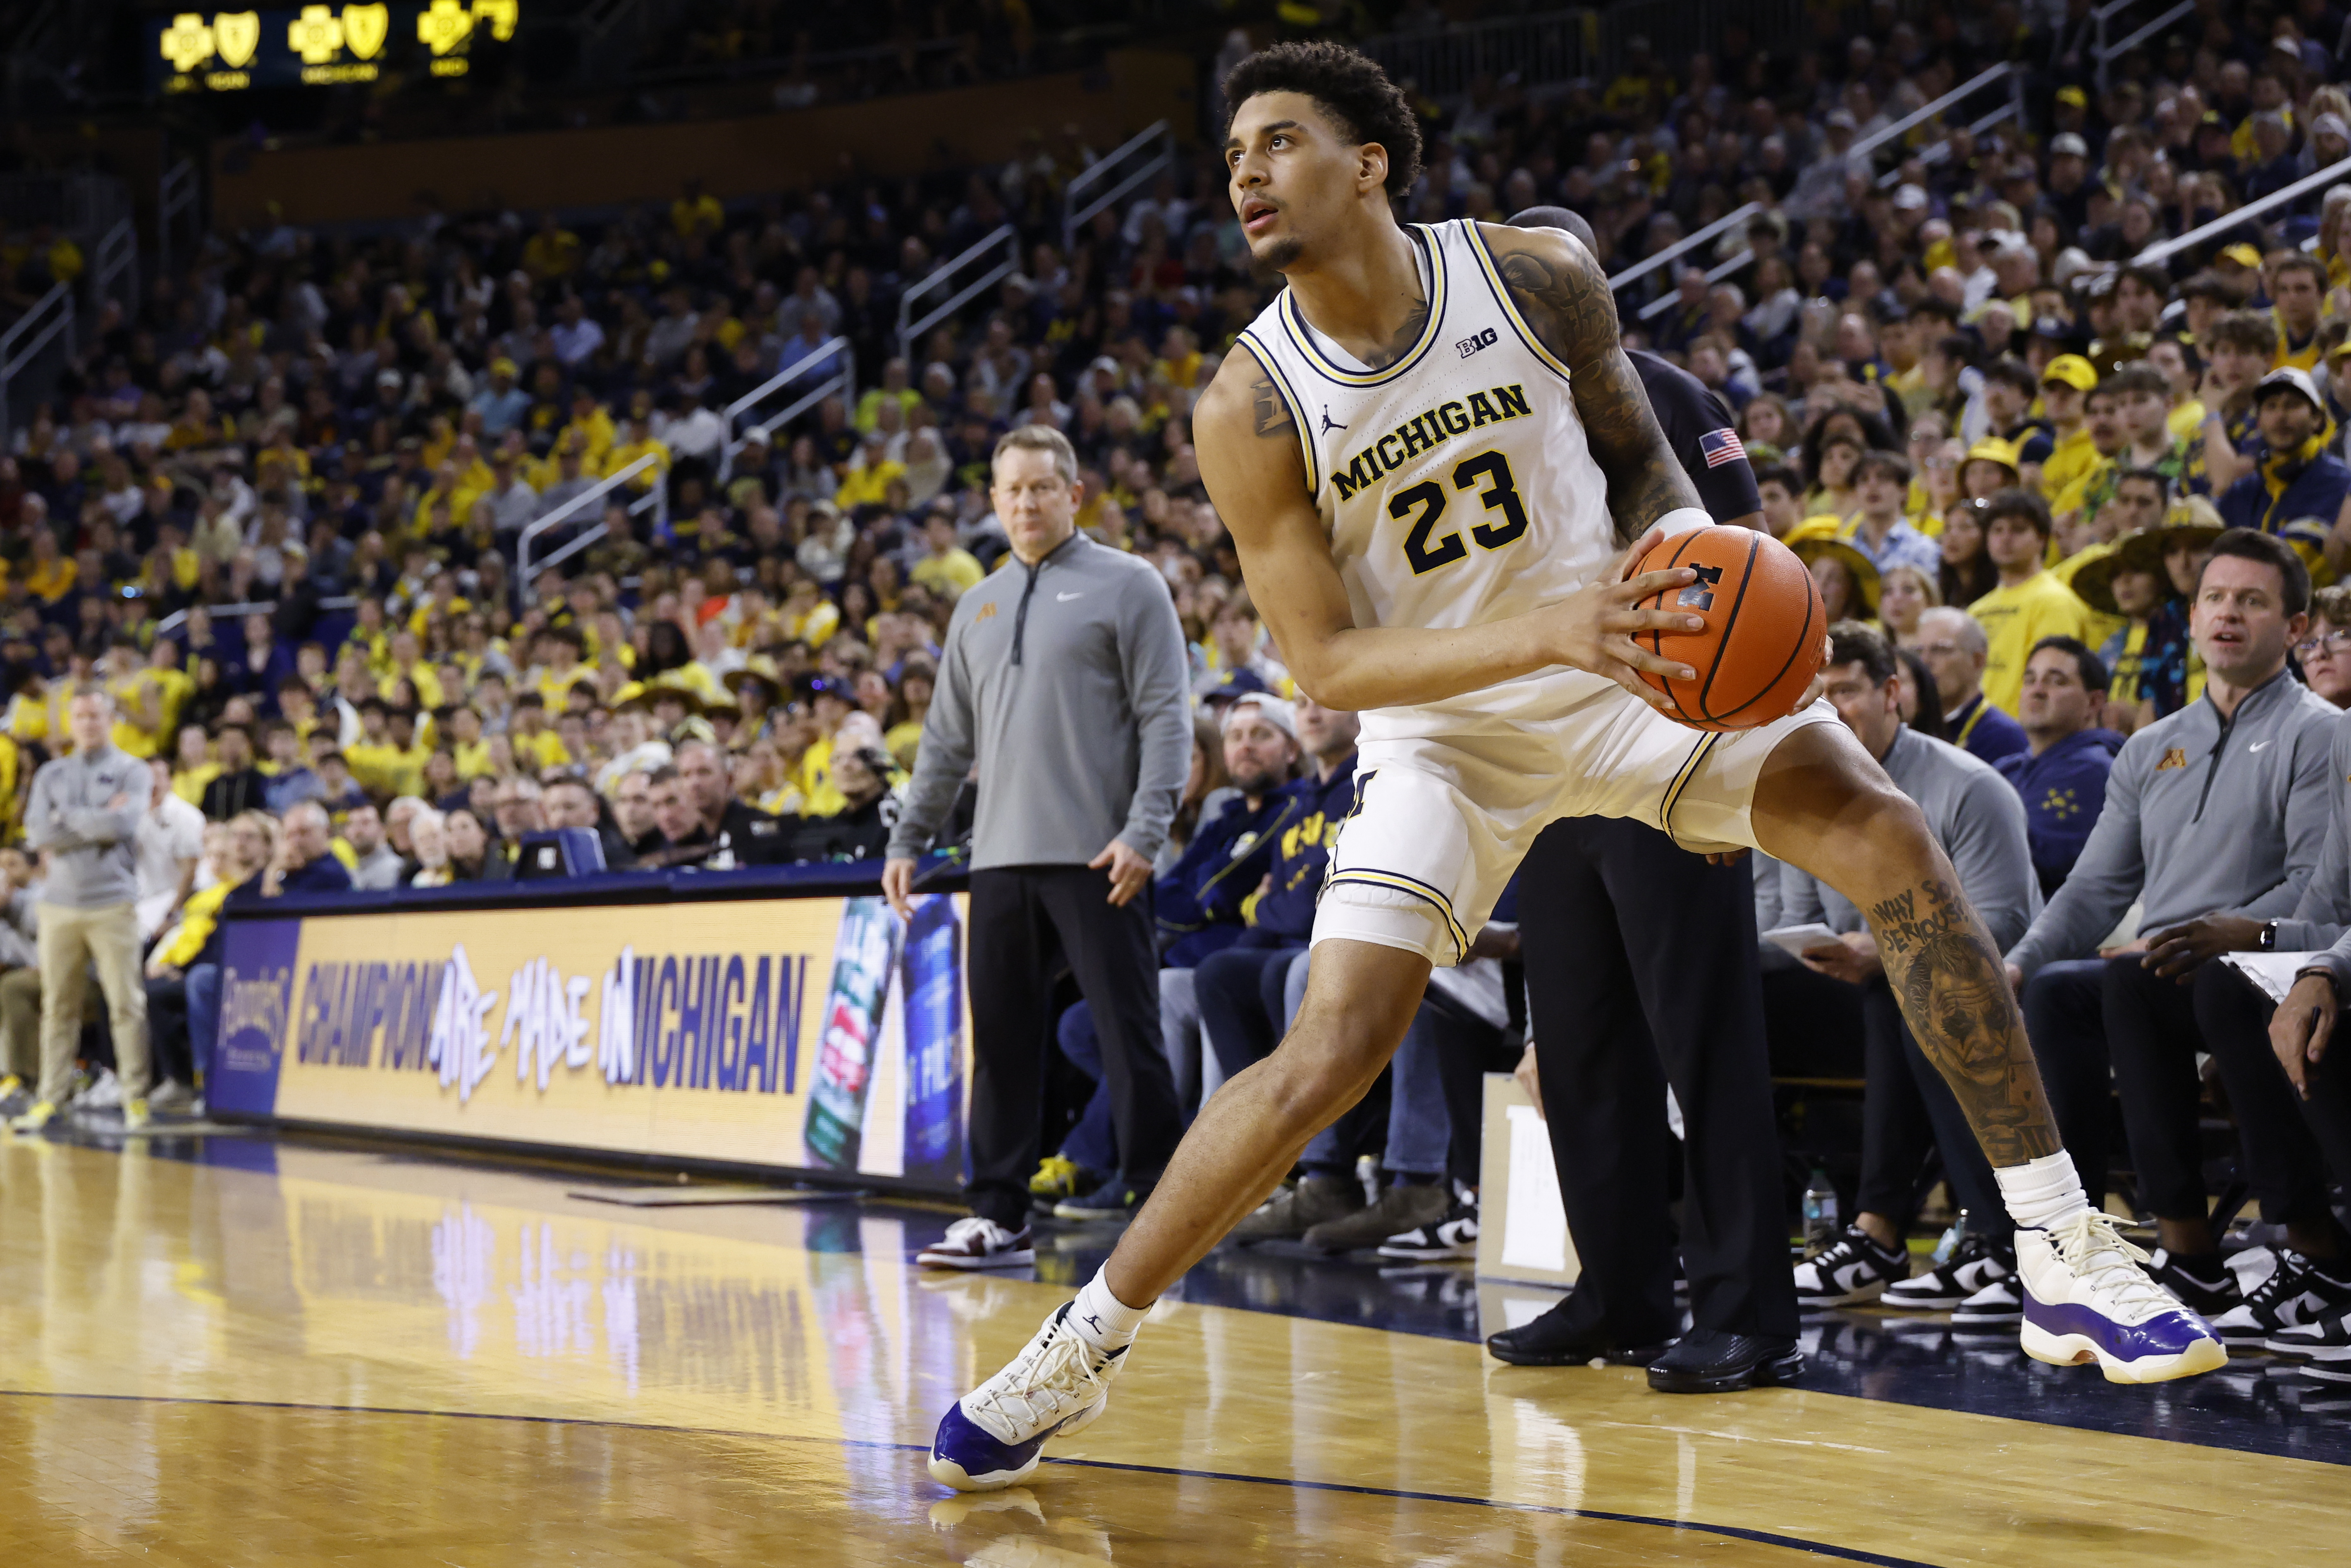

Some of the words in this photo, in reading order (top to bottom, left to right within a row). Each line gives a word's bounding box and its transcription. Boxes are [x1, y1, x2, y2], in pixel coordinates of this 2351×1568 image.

[1330, 383, 1534, 503] MICHIGAN
[1387, 448, 1529, 577] 23
[1677, 563, 1723, 611] M
[1873, 889, 1914, 924] WHY
[1921, 880, 1952, 904] SO
[1882, 895, 1969, 954] SERIOUS?
[428, 942, 498, 1103] ARE
[499, 955, 593, 1091] MADE
[598, 944, 633, 1085] IN
[1012, 1362, 1115, 1439] JORDN
